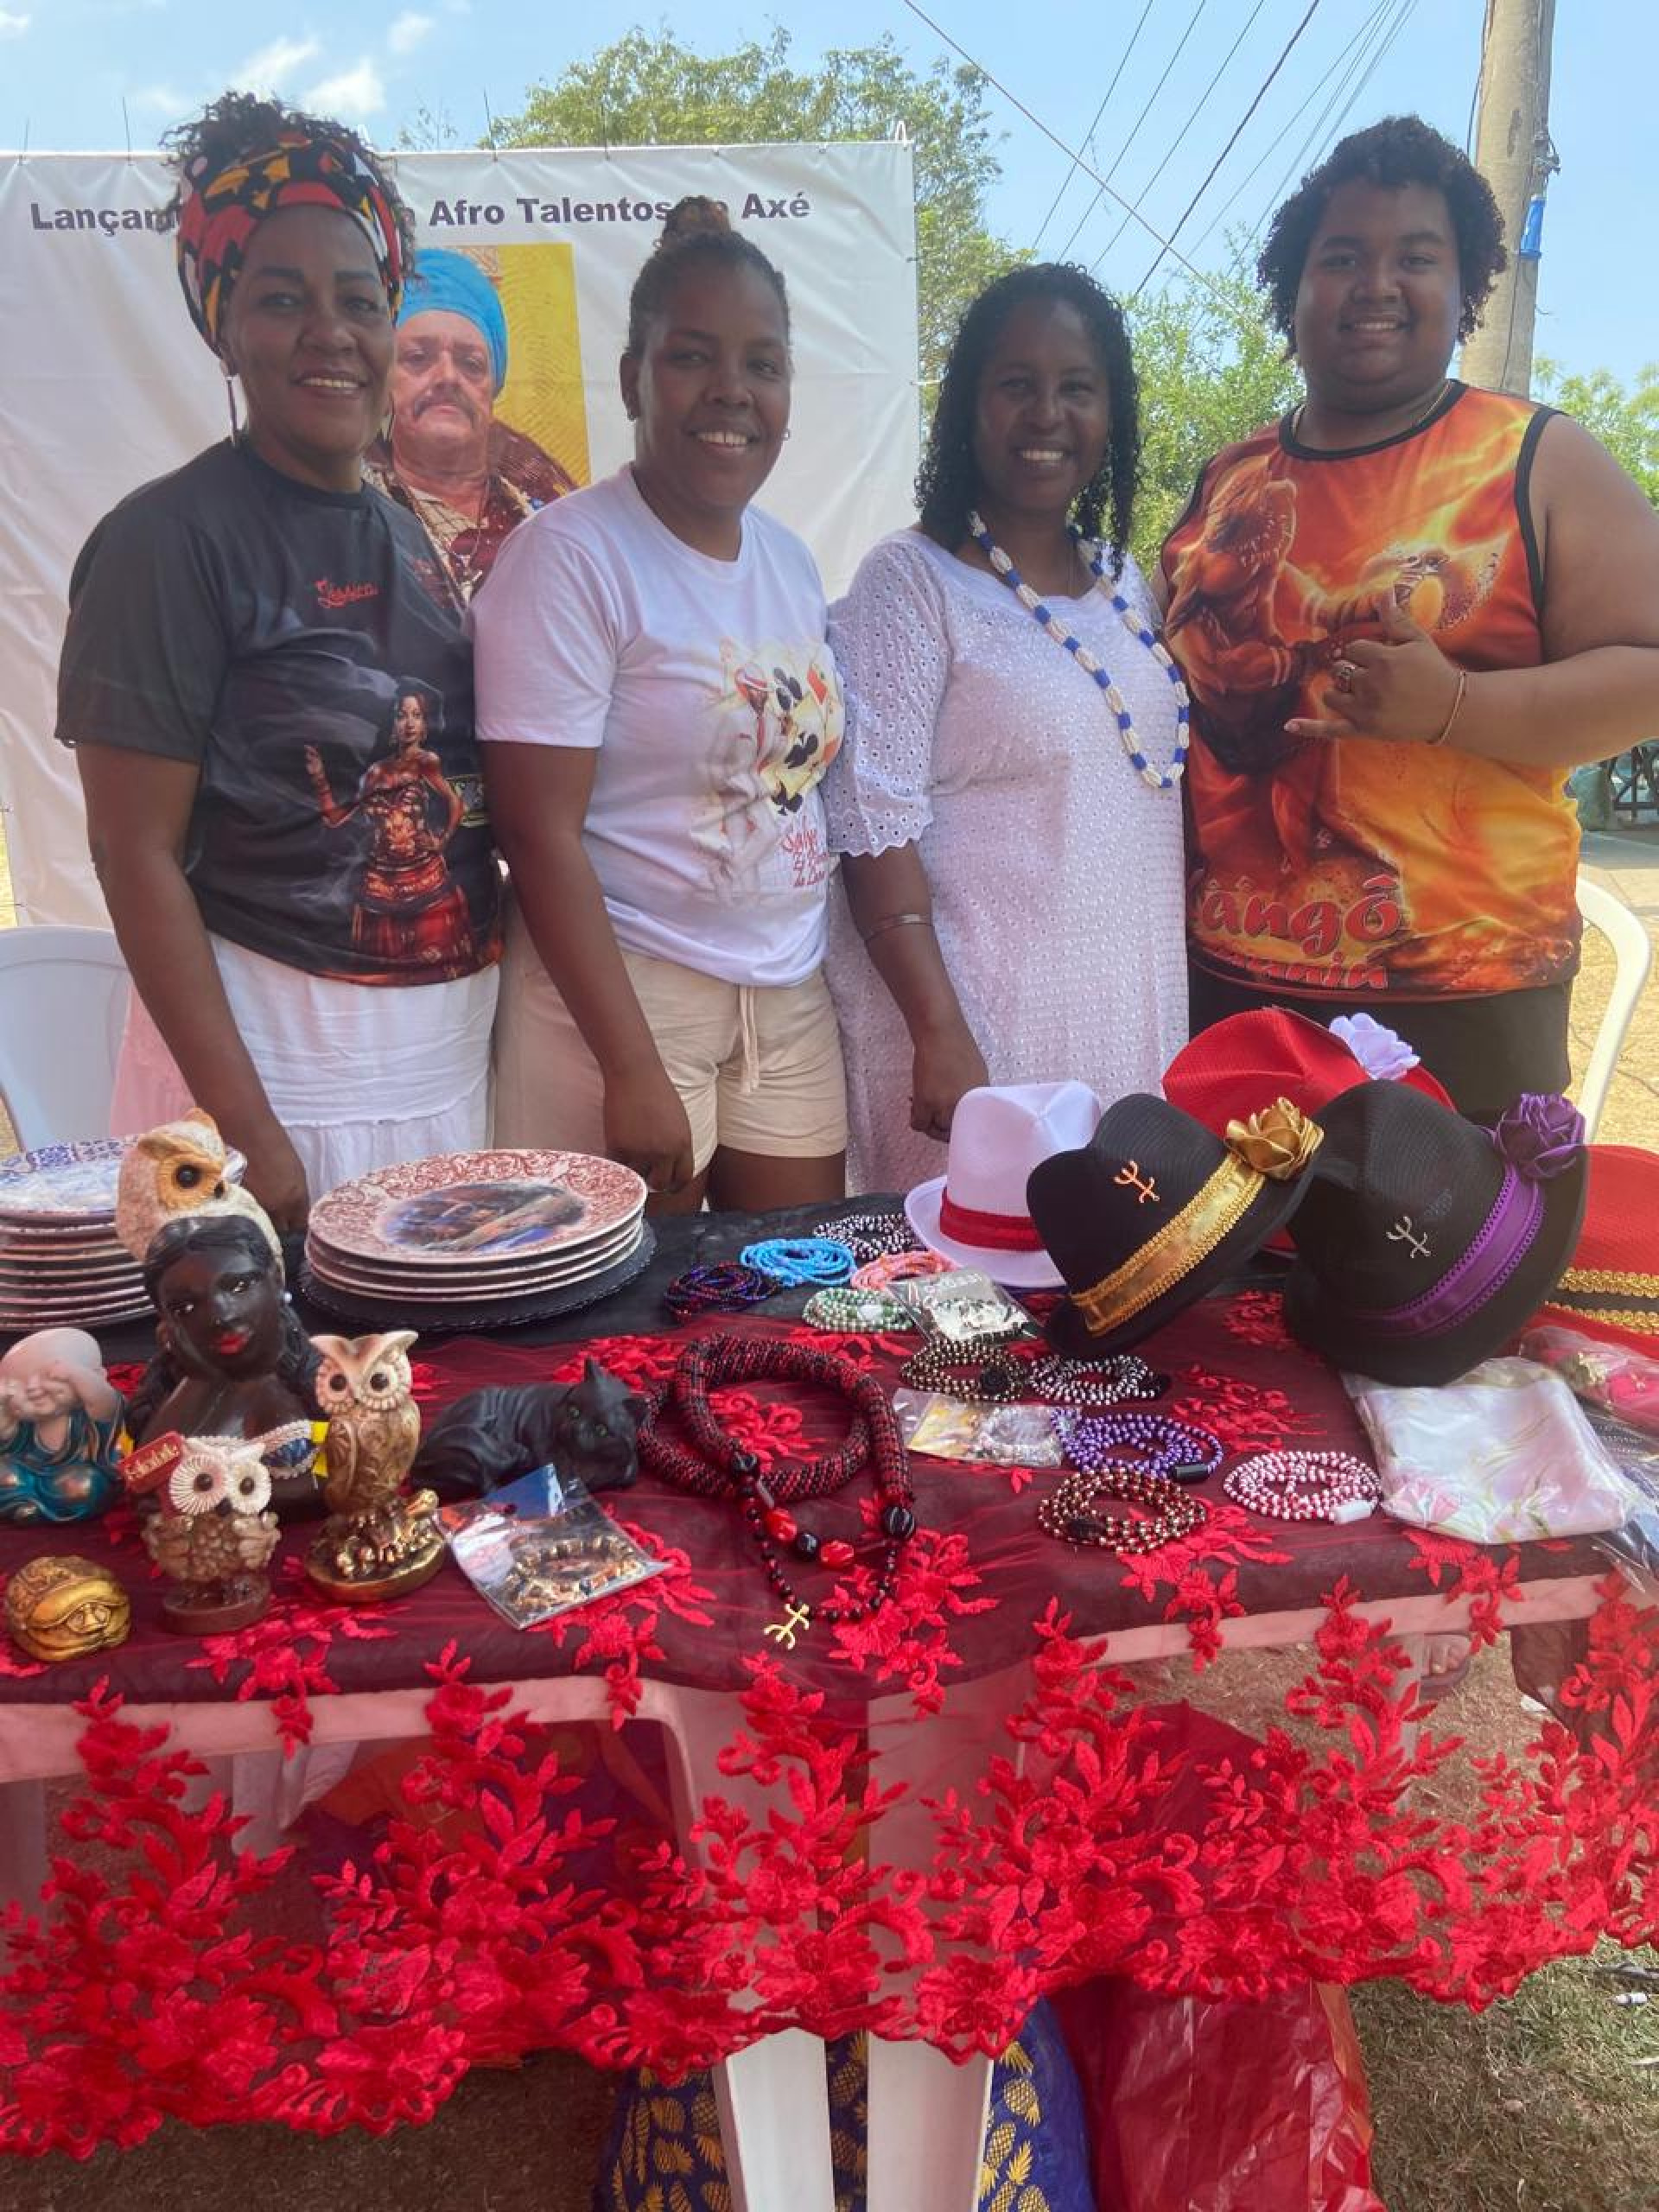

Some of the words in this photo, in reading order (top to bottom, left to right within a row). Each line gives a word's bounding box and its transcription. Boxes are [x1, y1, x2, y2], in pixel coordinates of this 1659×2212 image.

[29, 202, 179, 237] Lançam
[429, 200, 505, 226] Afro
[516, 196, 672, 224] Talentos
[741, 191, 810, 219] Axé
[1201, 874, 1401, 957] angô
